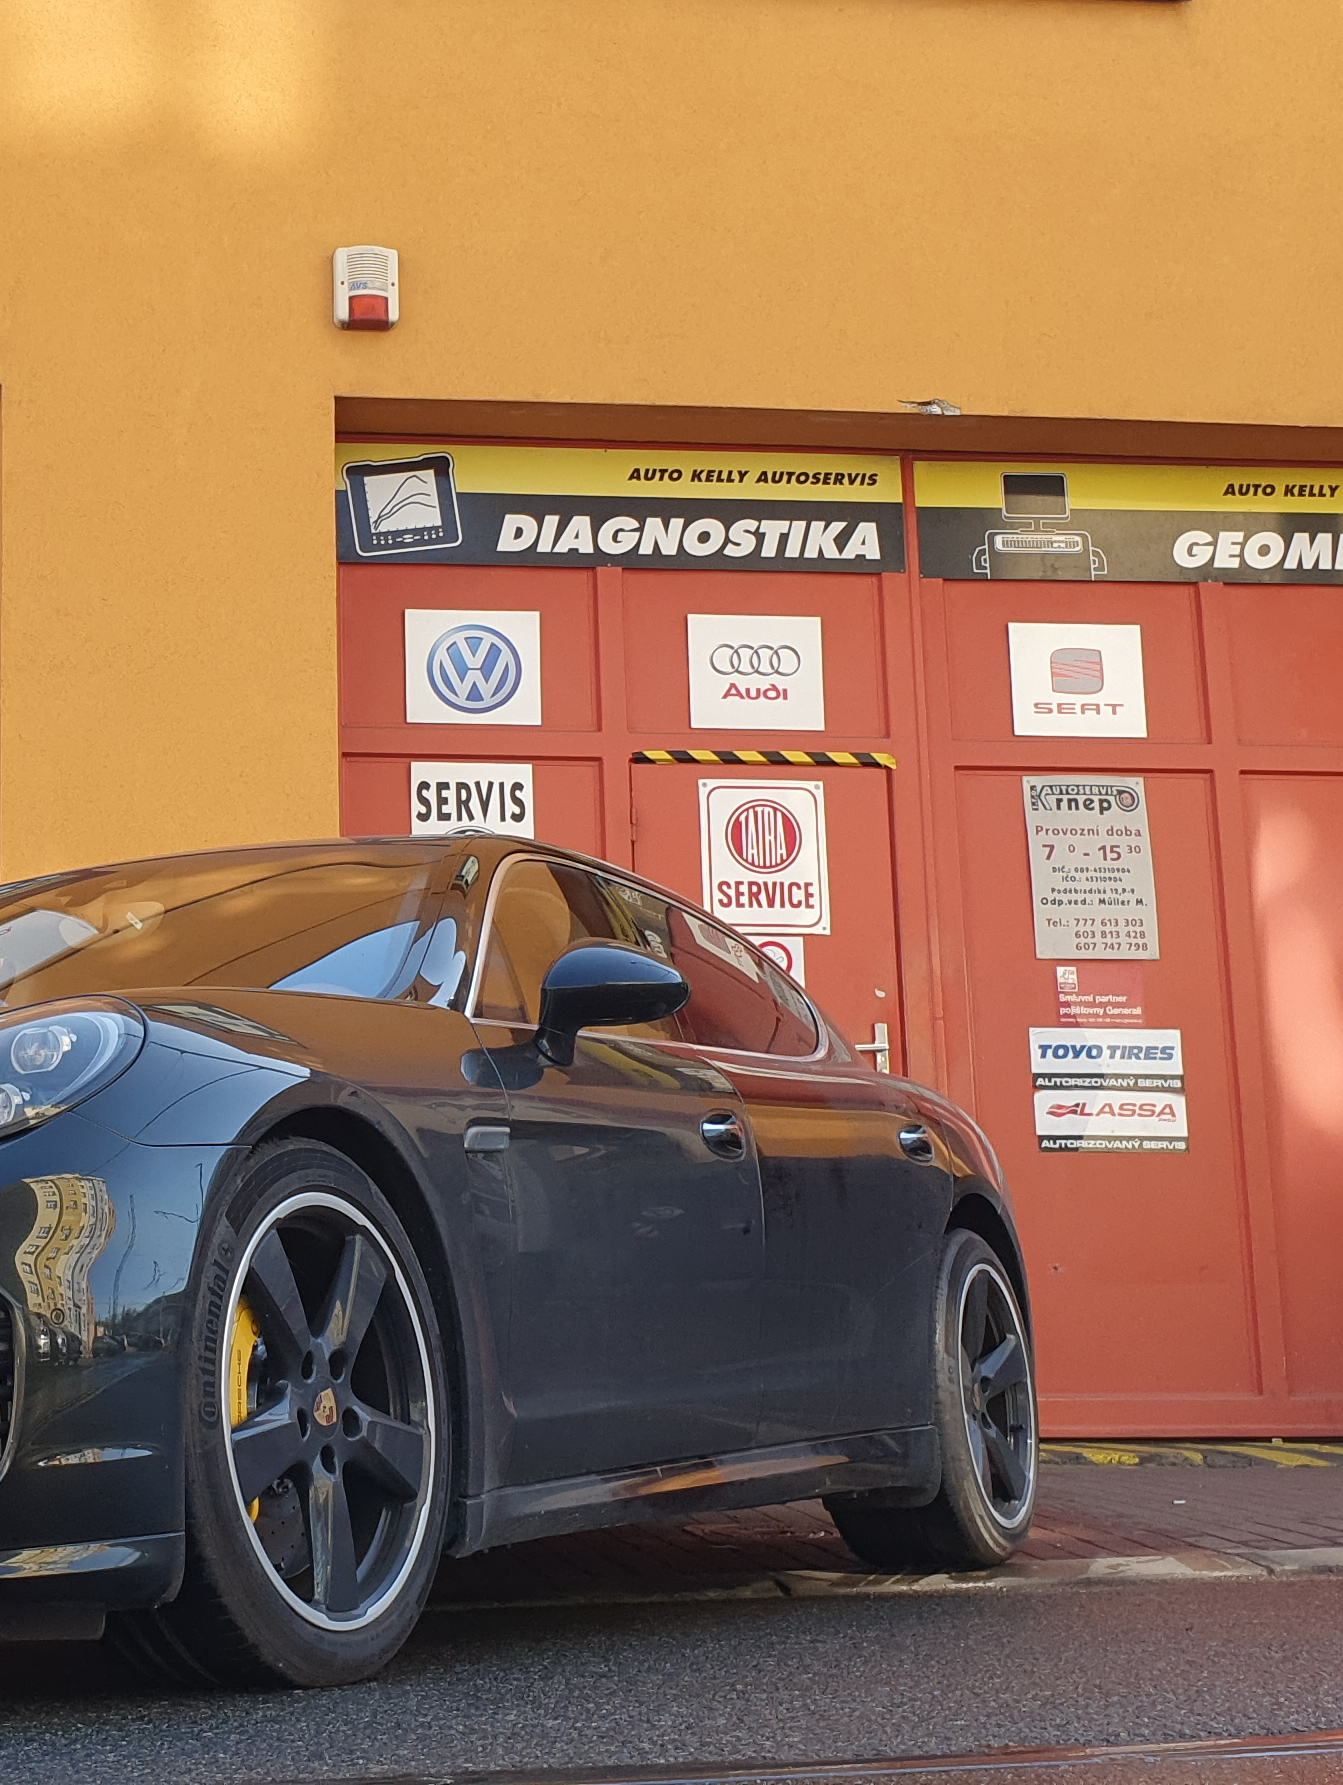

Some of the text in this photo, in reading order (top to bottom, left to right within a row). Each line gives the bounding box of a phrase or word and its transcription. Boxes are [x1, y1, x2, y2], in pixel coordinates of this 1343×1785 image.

[627, 467, 879, 487] AUTO KELLY AUTOSERVIS
[1223, 483, 1341, 498] AUTO KELLY
[496, 513, 881, 560] DIAGNOSTIKA
[721, 682, 789, 701] Audi
[1032, 702, 1125, 716] SEAT
[416, 780, 527, 824] SERVIS
[738, 804, 788, 873] TATRA
[1035, 825, 1142, 837] Provozní doba
[1041, 844, 1055, 861] 7
[1097, 845, 1122, 861] 15
[1126, 845, 1142, 854] 30
[717, 880, 815, 910] SERVICE
[1073, 918, 1096, 928] 777
[1100, 918, 1119, 928] 613
[1123, 918, 1144, 928] 303
[1074, 930, 1146, 940] 603 813 428
[1075, 942, 1148, 952] 607 747 798
[1038, 1044, 1176, 1061] TOYO TIRES
[1035, 1076, 1182, 1088] AUTORIZOVANÝ SERVIS
[1078, 1102, 1177, 1118] LASSA
[1040, 1138, 1187, 1150] AUTORIZOVANÝ SERVIS
